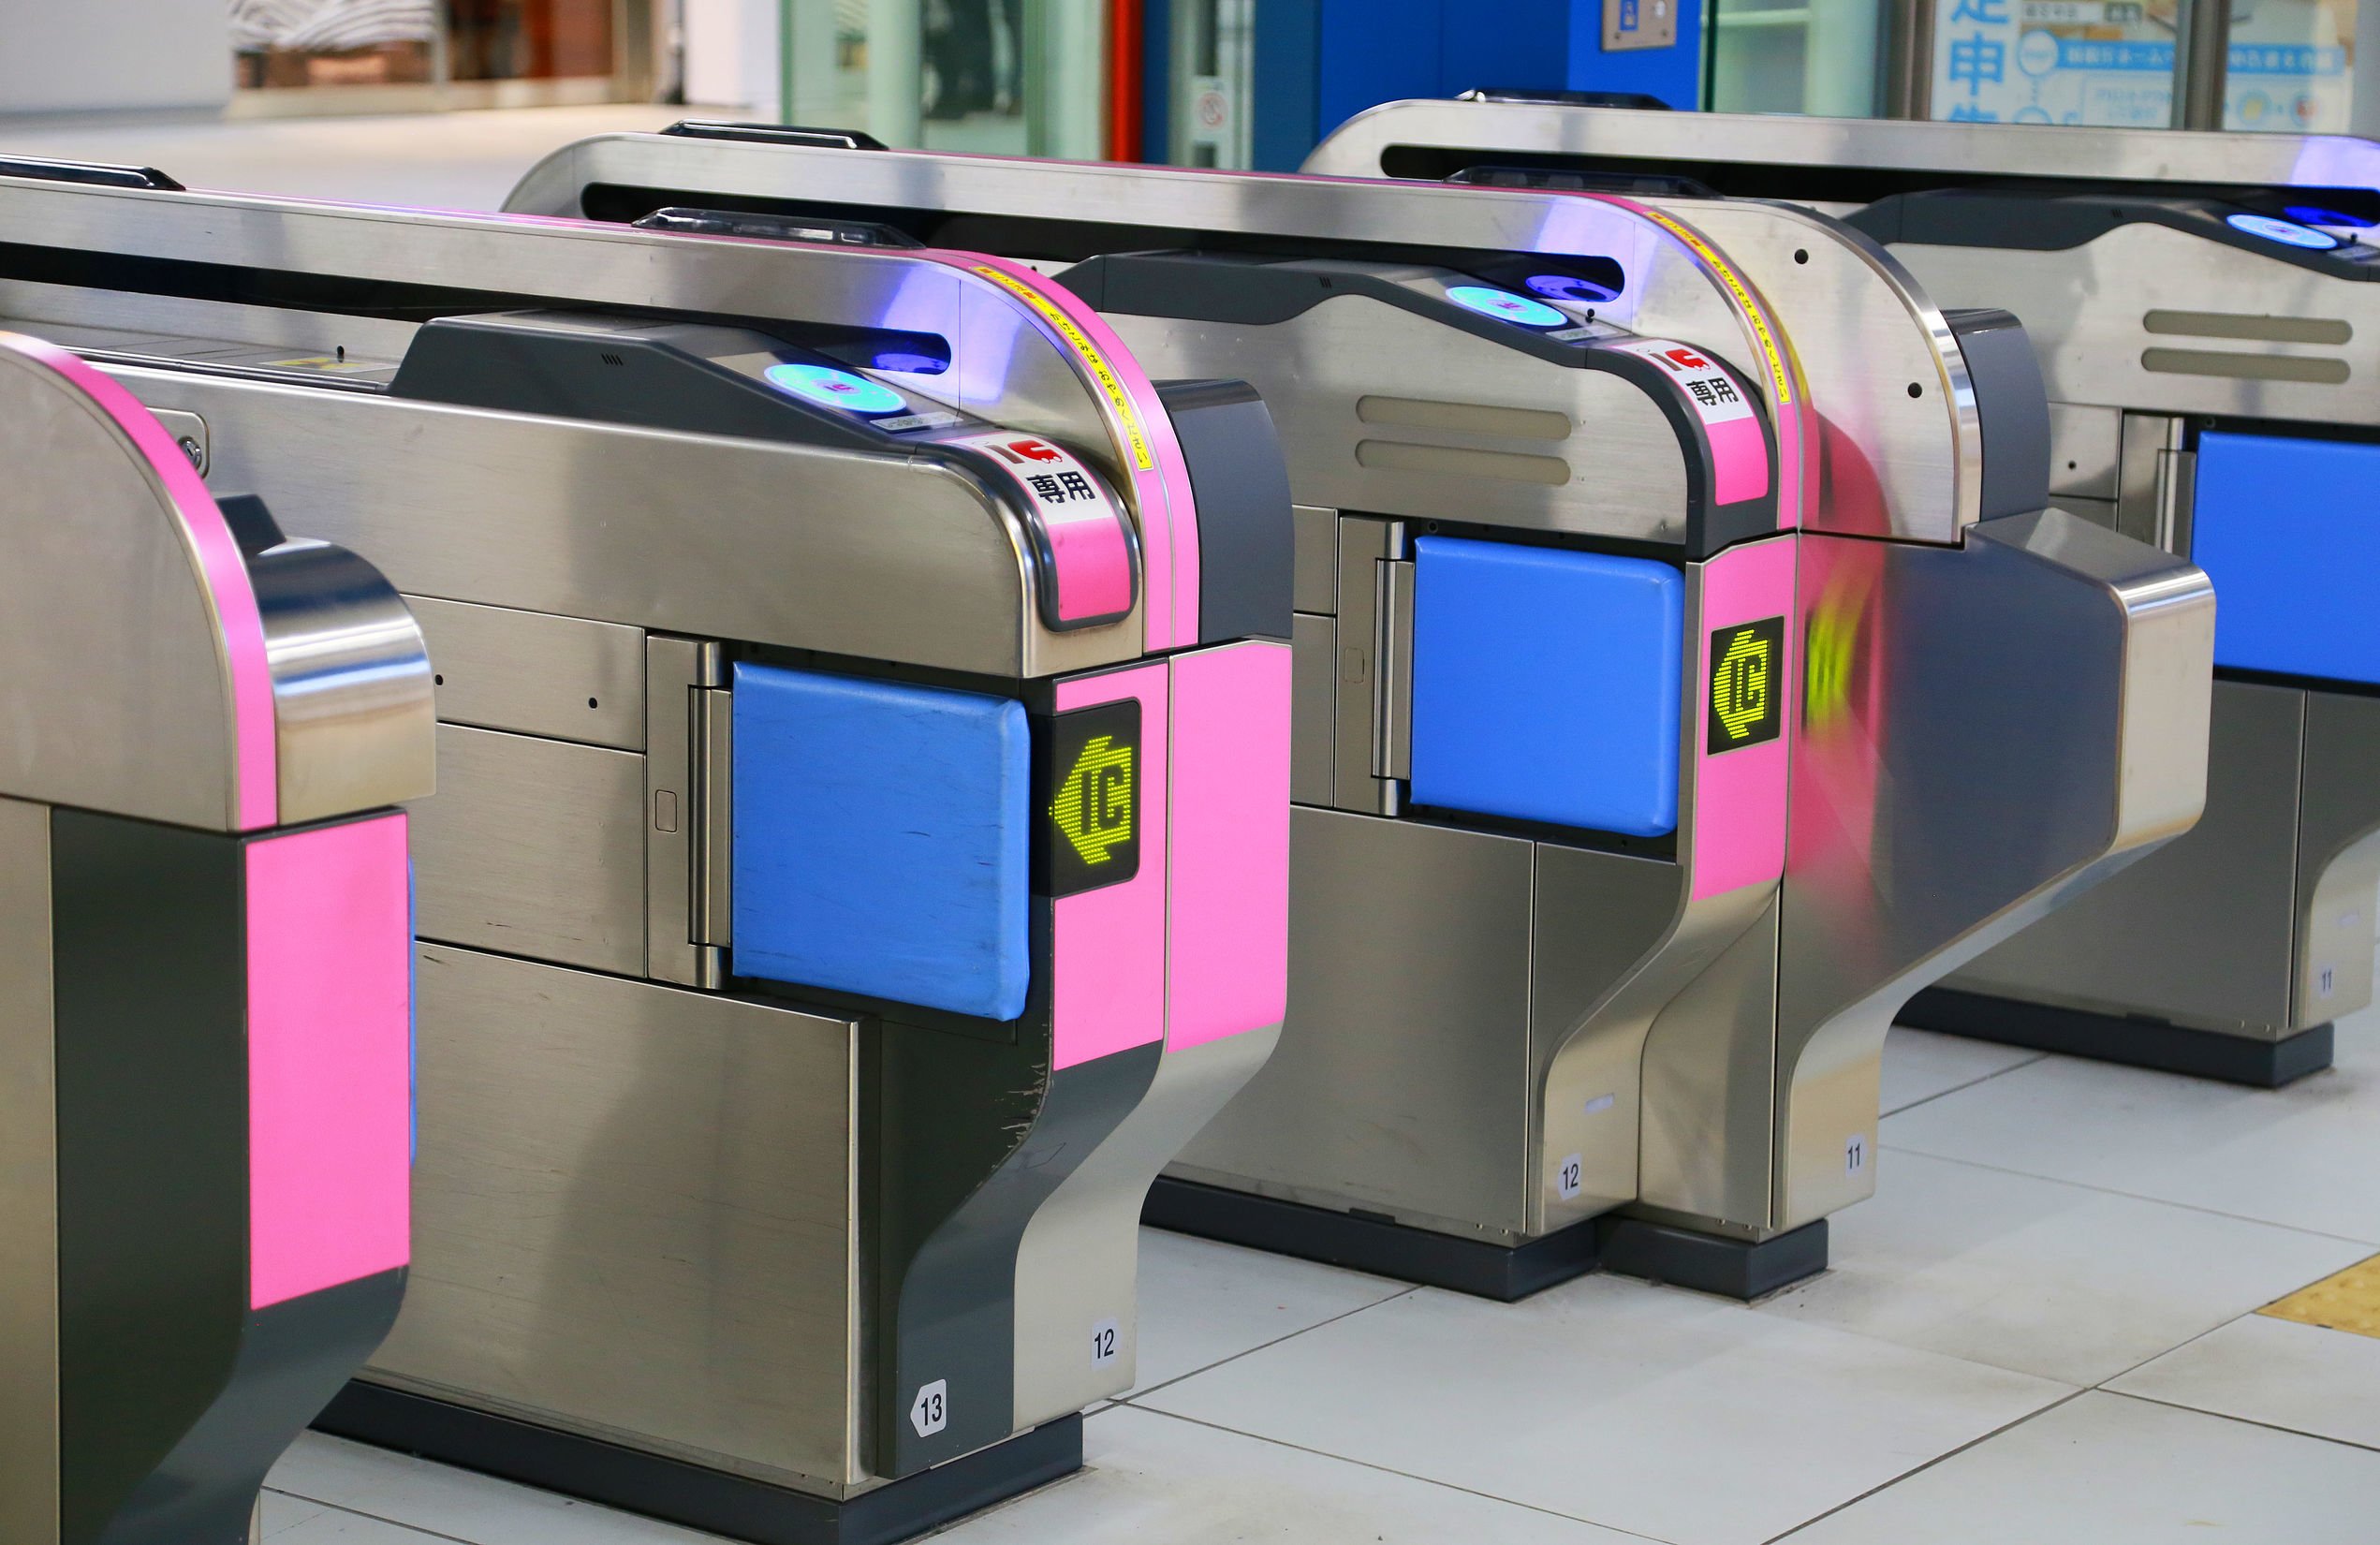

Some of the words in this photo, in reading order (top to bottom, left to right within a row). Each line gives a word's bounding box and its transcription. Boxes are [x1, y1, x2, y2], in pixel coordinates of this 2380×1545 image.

[1685, 376, 1740, 406] 専用
[1025, 470, 1096, 504] 専用
[1729, 650, 1764, 714] IC
[1080, 763, 1124, 836] IC
[2321, 967, 2332, 993] 11
[1846, 1141, 1862, 1170] 11
[1561, 1162, 1579, 1191] 12
[1094, 1327, 1115, 1360] 12
[920, 1392, 943, 1426] 13
